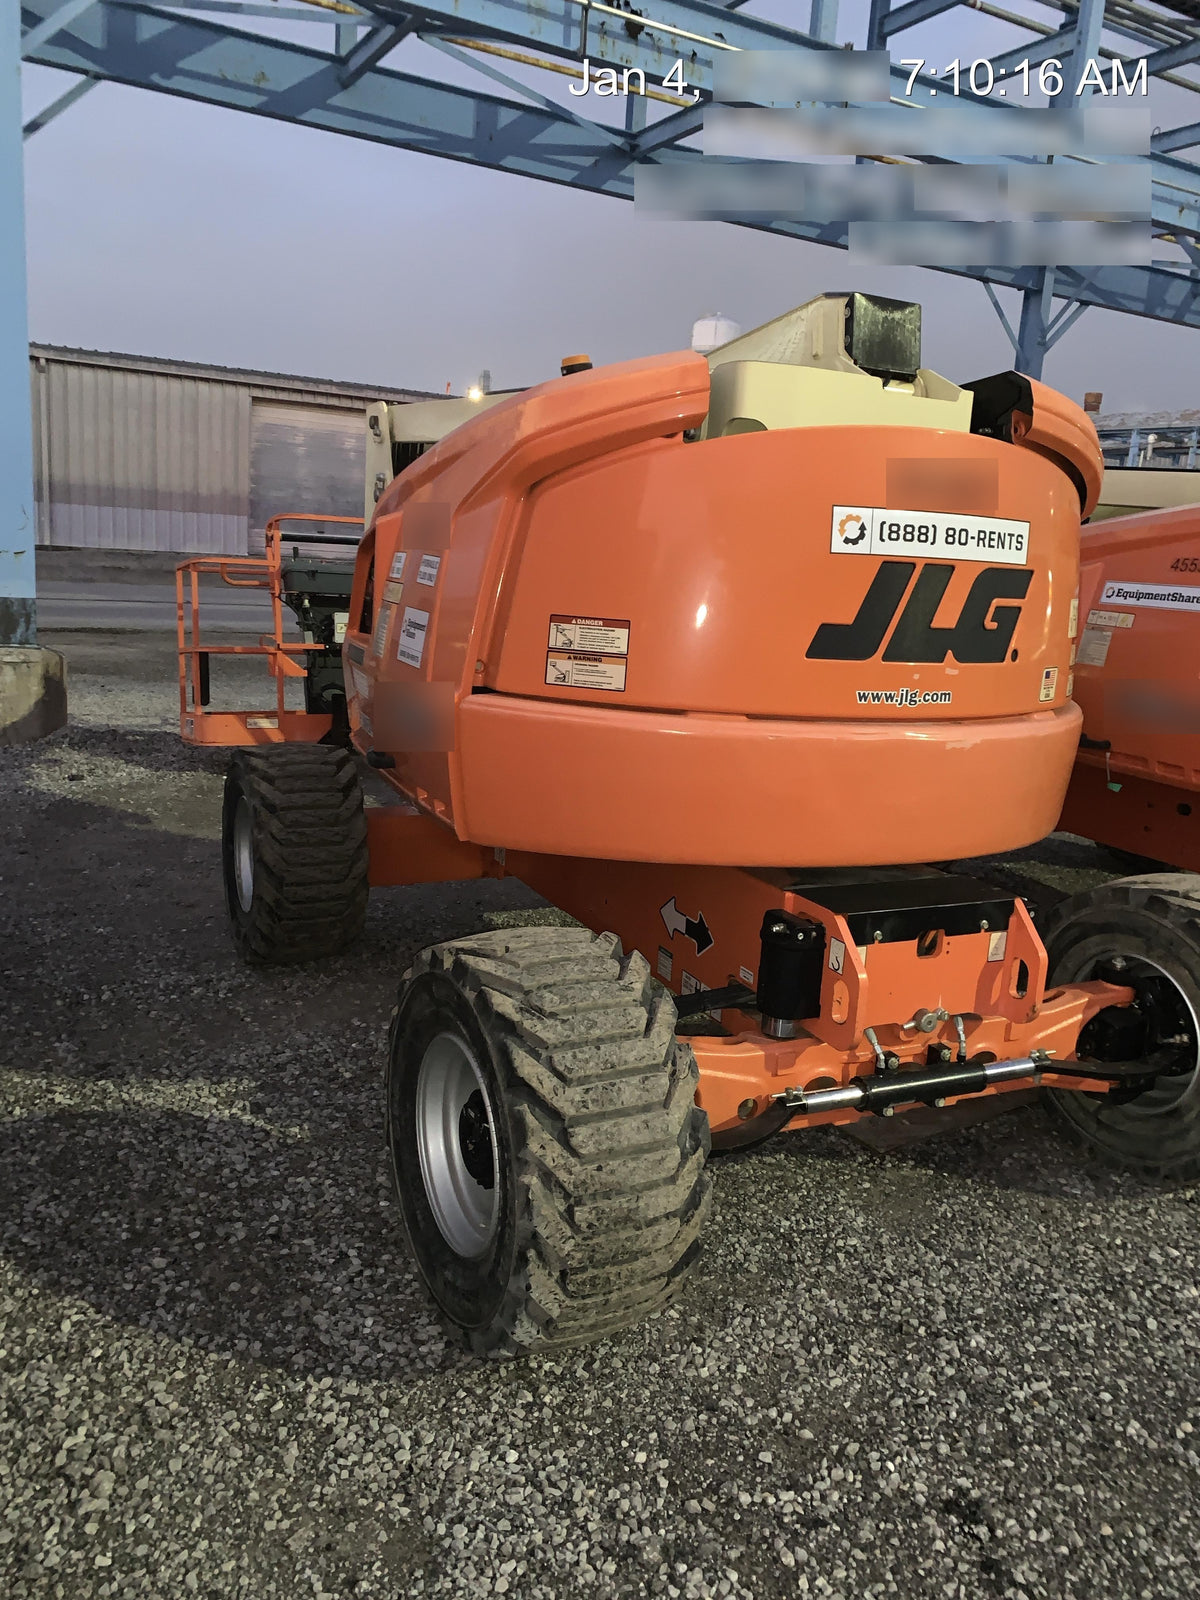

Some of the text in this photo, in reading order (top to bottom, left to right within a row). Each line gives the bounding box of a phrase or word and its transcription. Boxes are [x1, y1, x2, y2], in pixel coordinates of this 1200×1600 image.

[879, 520, 1024, 552] (888) 80-RENTS
[1170, 557, 1200, 573] 455
[1115, 587, 1200, 604] EquipmentShare
[576, 618, 604, 627] DANGER
[572, 655, 603, 663] WARNING
[857, 689, 952, 707] www.jlg.com
